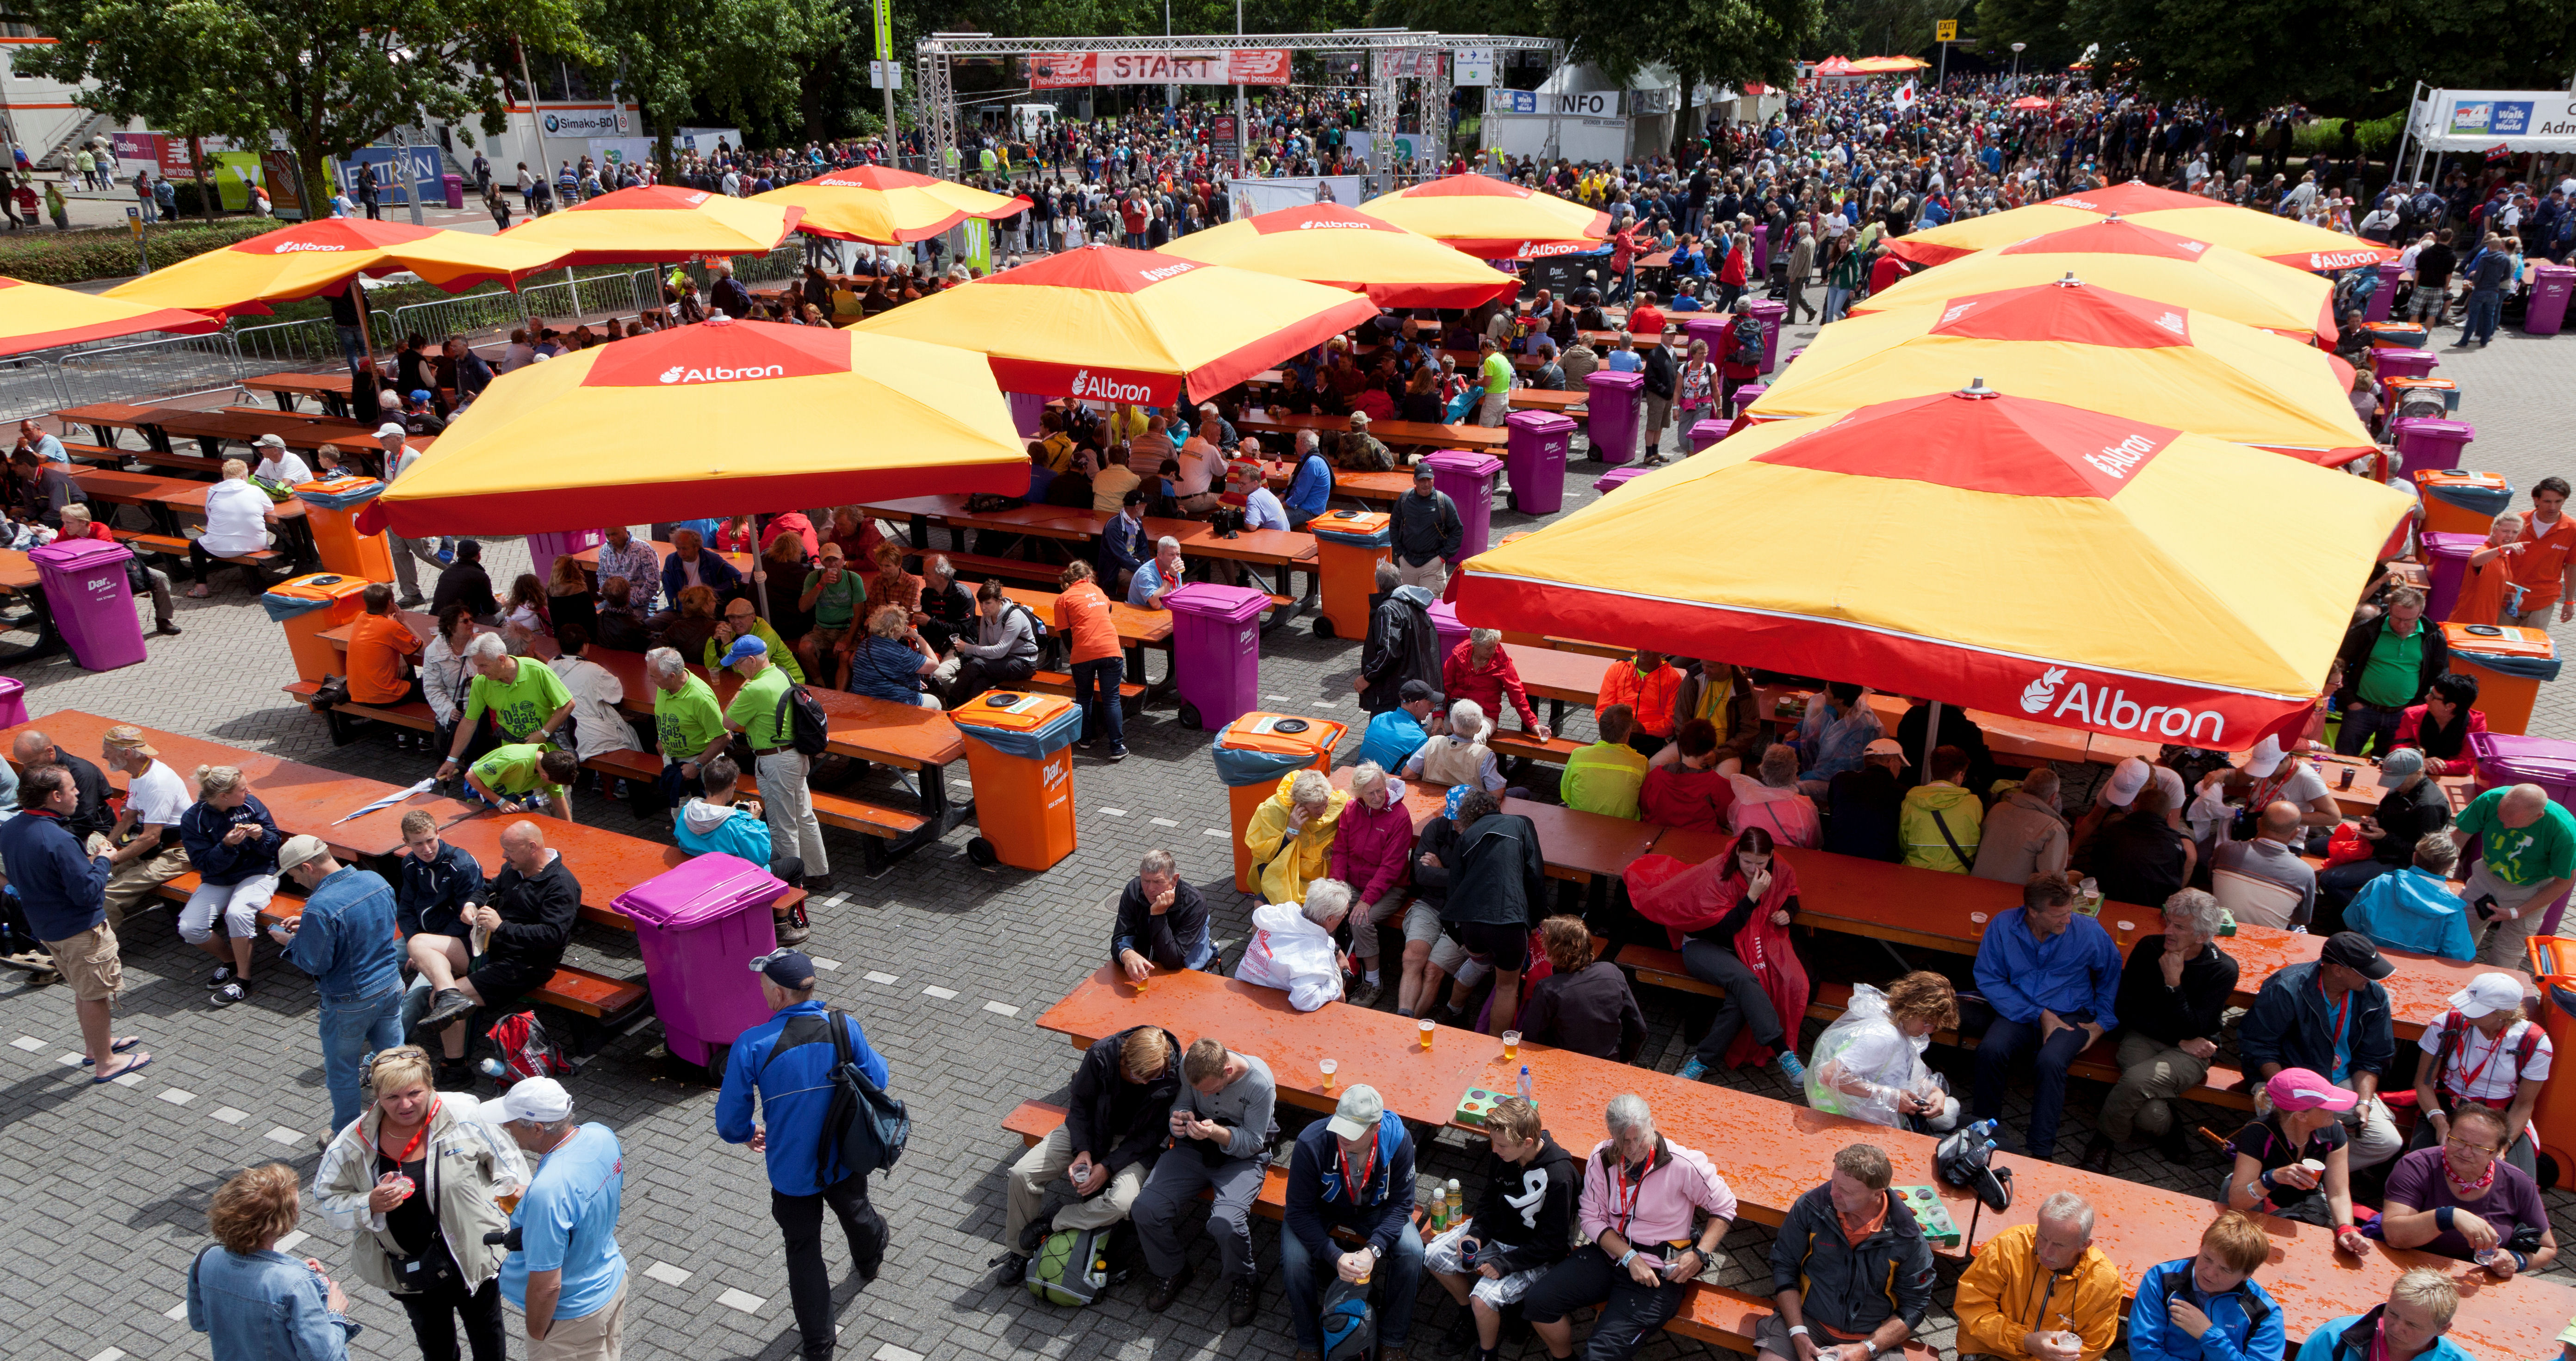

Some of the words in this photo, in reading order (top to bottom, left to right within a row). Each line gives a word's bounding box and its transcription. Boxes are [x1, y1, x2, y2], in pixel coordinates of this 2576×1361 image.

[1939, 22, 1955, 30] EXIT
[1113, 55, 1207, 78] START
[1056, 76, 1091, 85] balance
[1251, 75, 1287, 84] balance
[2498, 111, 2525, 119] Walk
[560, 117, 613, 129] Simako-BD
[116, 140, 138, 153] isolve
[827, 179, 862, 187] Albron
[1313, 221, 1370, 229] Albron
[286, 242, 345, 253] Albron
[1528, 244, 1579, 257] Albron
[2323, 251, 2379, 268] Albron
[1150, 263, 1195, 279] Albron
[682, 365, 783, 383] Albron
[1085, 376, 1151, 402] Albron
[2097, 434, 2156, 473] Albron
[2054, 682, 2224, 742] Albron
[1253, 964, 1270, 978] Dagblad
[522, 1050, 541, 1077] SALOMON
